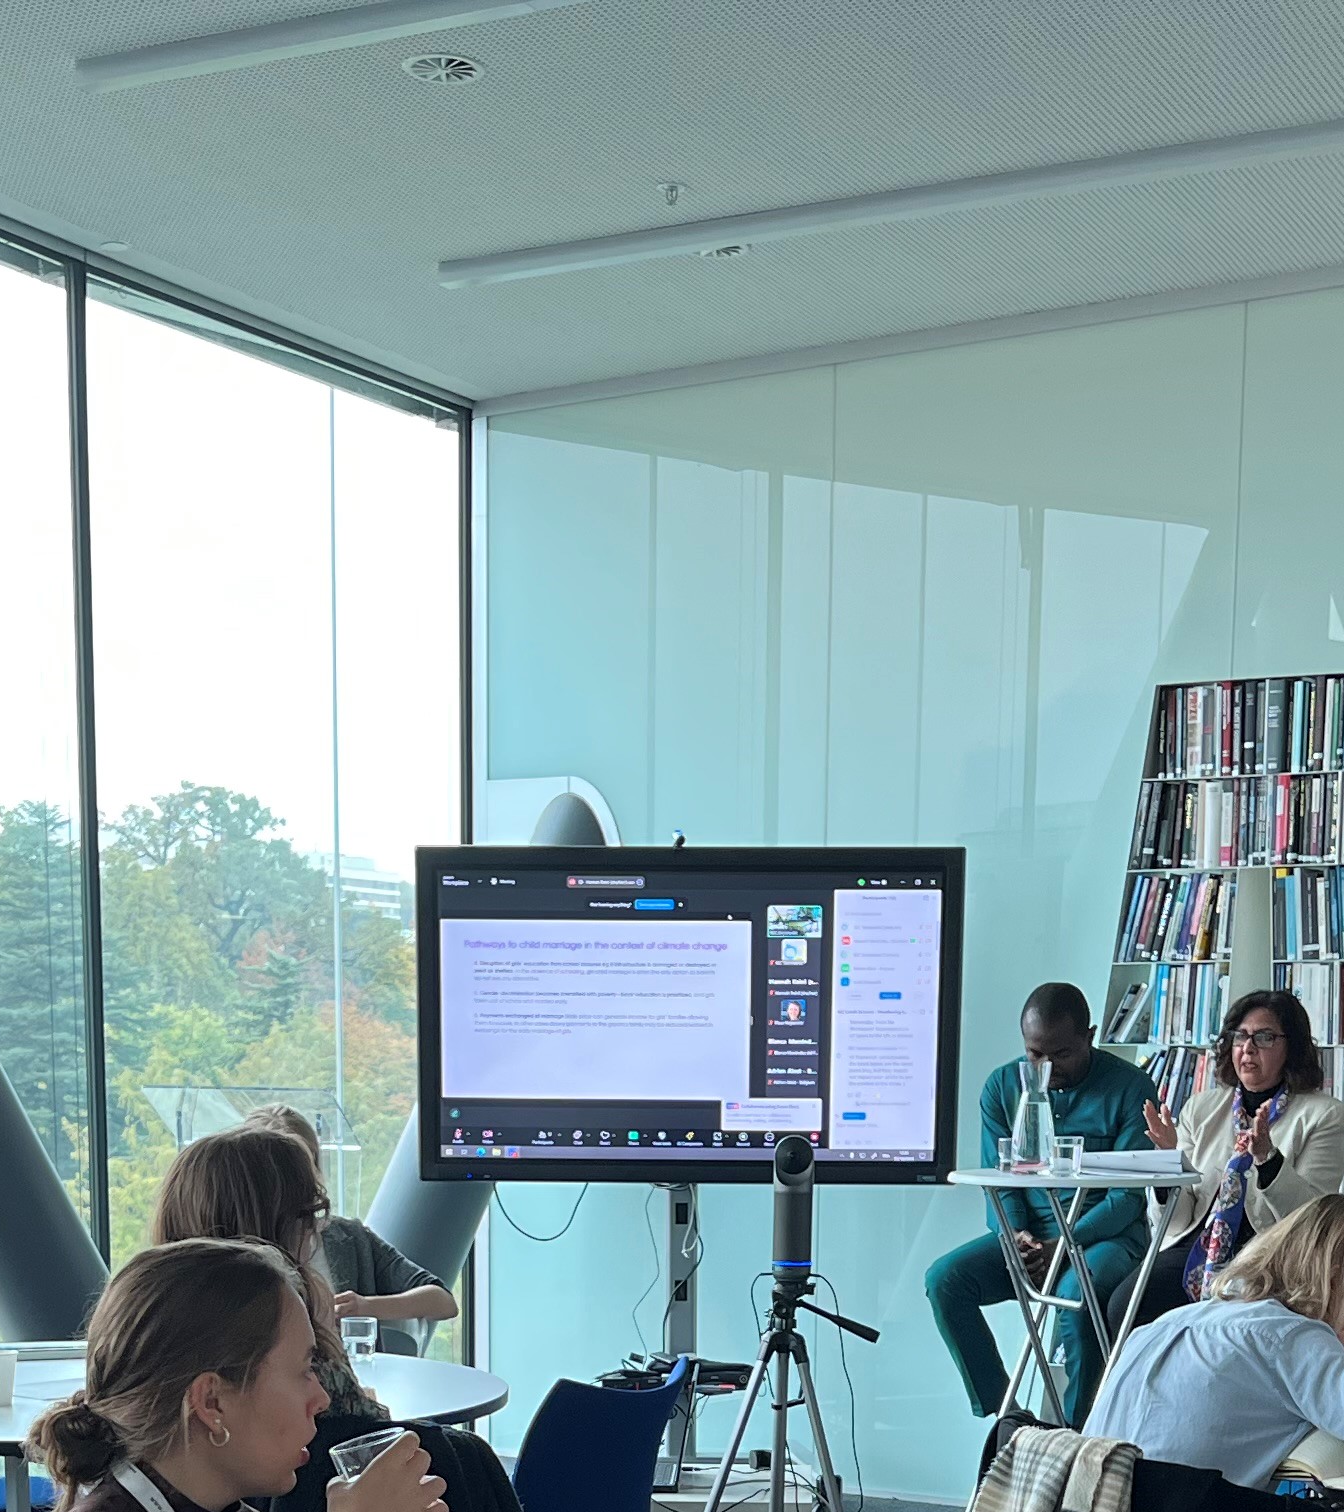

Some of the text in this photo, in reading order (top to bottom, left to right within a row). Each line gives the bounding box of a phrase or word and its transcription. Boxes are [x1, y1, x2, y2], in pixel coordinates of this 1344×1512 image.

[463, 939, 506, 951] Pathways
[508, 940, 517, 949] to
[519, 940, 540, 949] child
[542, 940, 582, 952] marriage
[594, 941, 609, 950] the
[646, 941, 656, 950] of
[657, 941, 690, 950] climate
[692, 942, 728, 952] change
